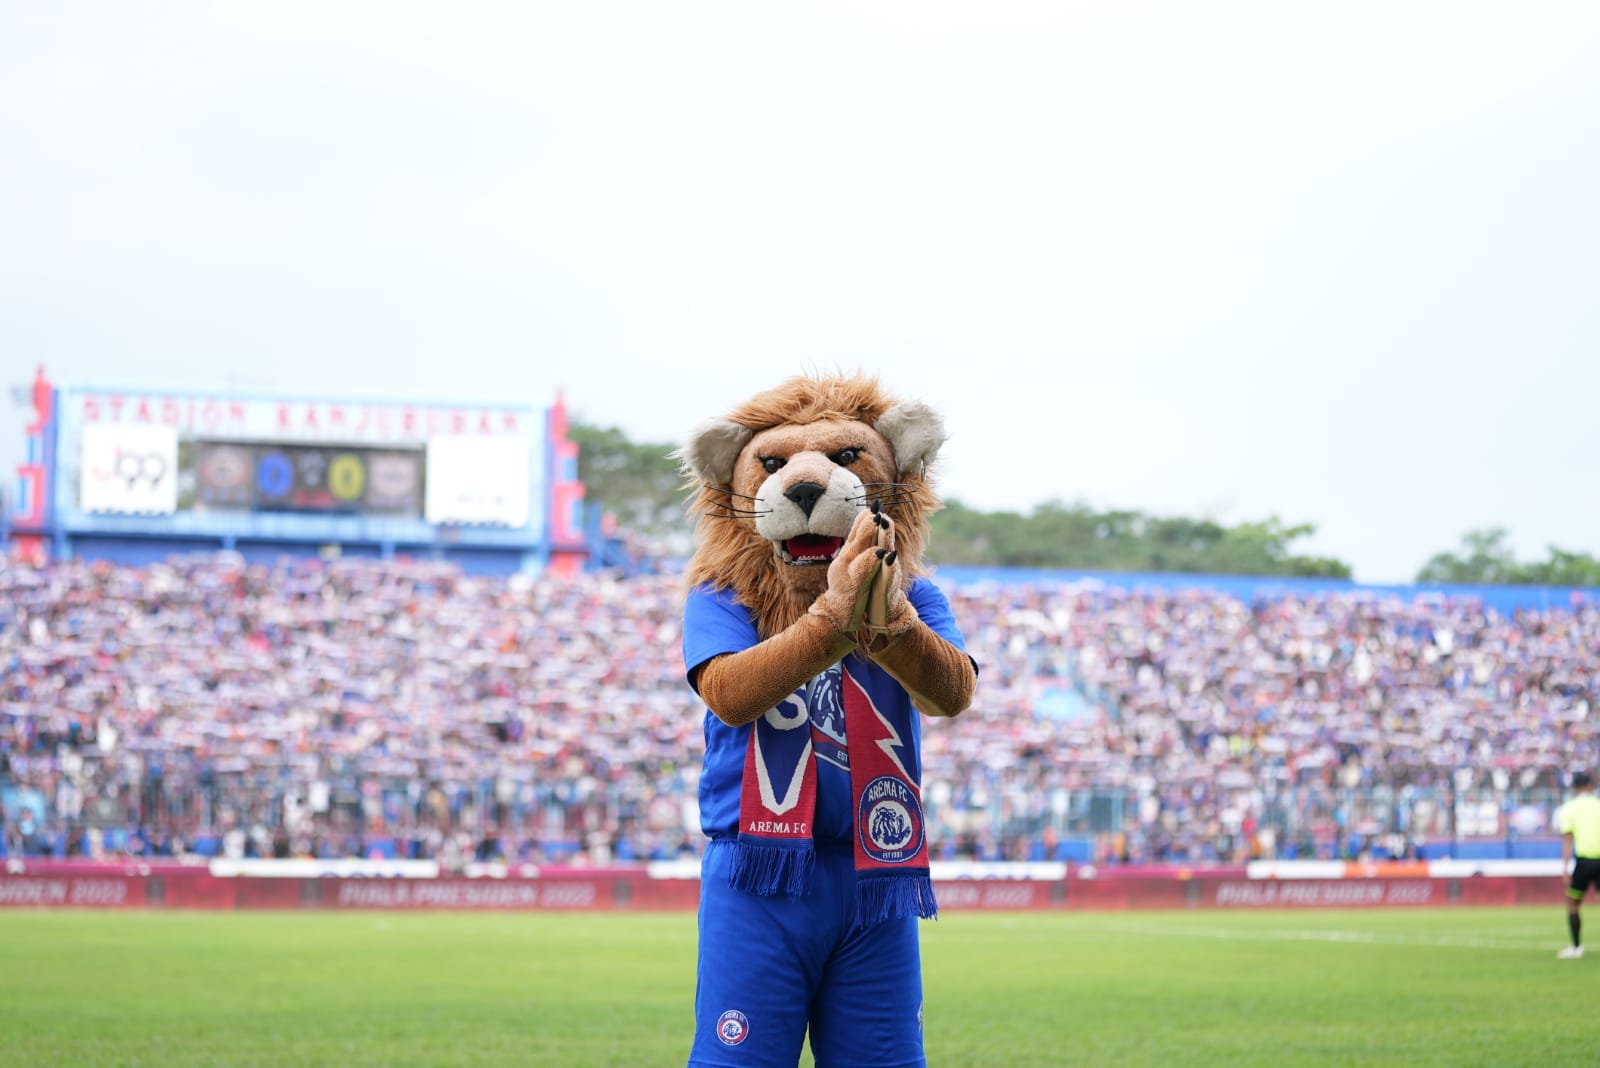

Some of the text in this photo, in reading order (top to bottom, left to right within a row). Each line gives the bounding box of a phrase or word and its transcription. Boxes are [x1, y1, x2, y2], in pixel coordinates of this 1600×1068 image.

[257, 452, 293, 498] 0
[328, 454, 364, 501] 0
[868, 780, 908, 802] AREMA FC
[749, 820, 806, 834] AREMA FC
